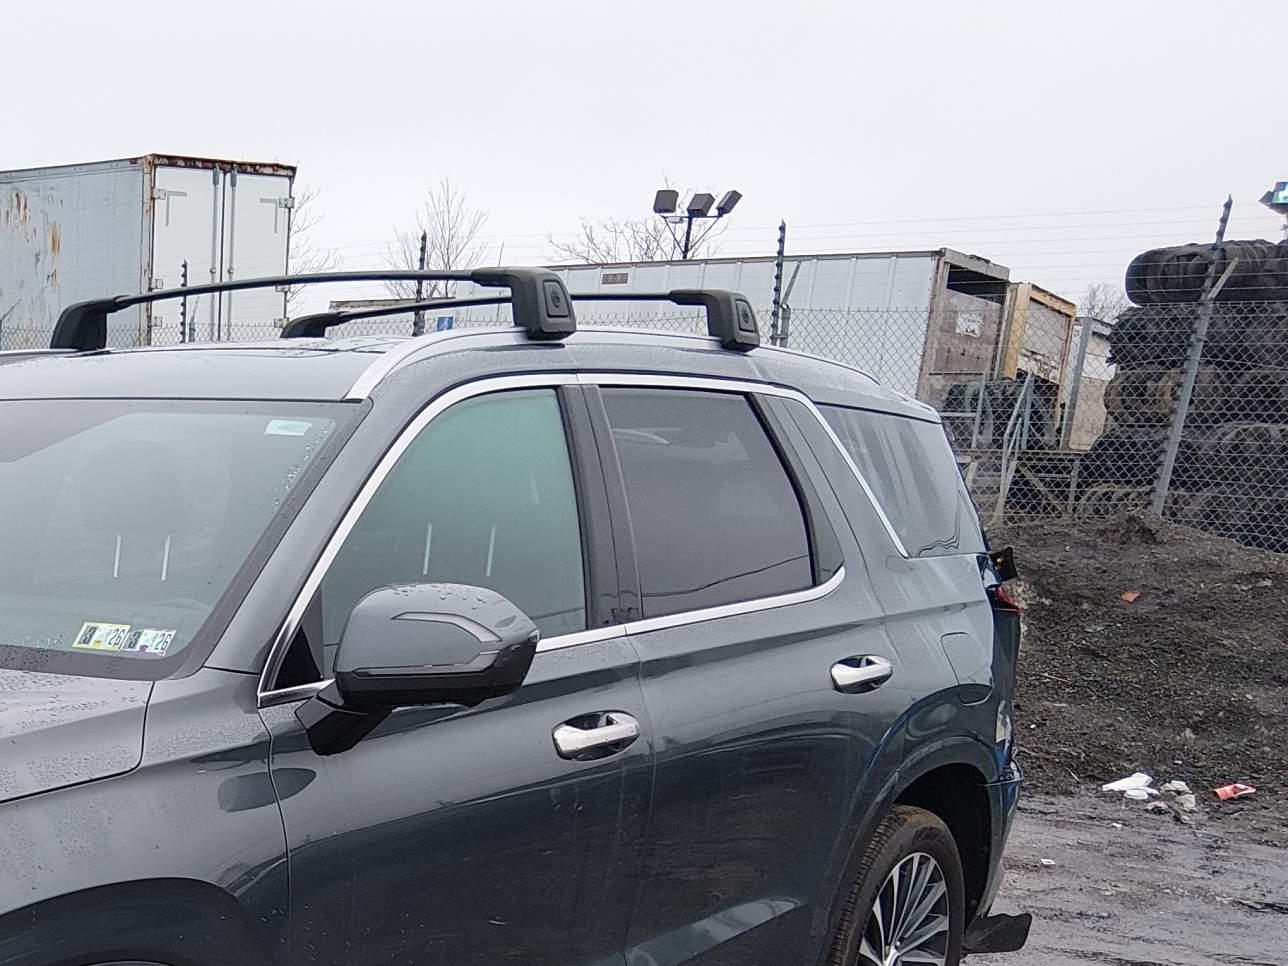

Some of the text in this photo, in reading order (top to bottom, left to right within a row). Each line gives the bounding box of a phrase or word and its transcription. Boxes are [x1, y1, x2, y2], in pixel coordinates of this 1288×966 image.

[108, 628, 125, 647] 26
[127, 631, 172, 651] 3 26
